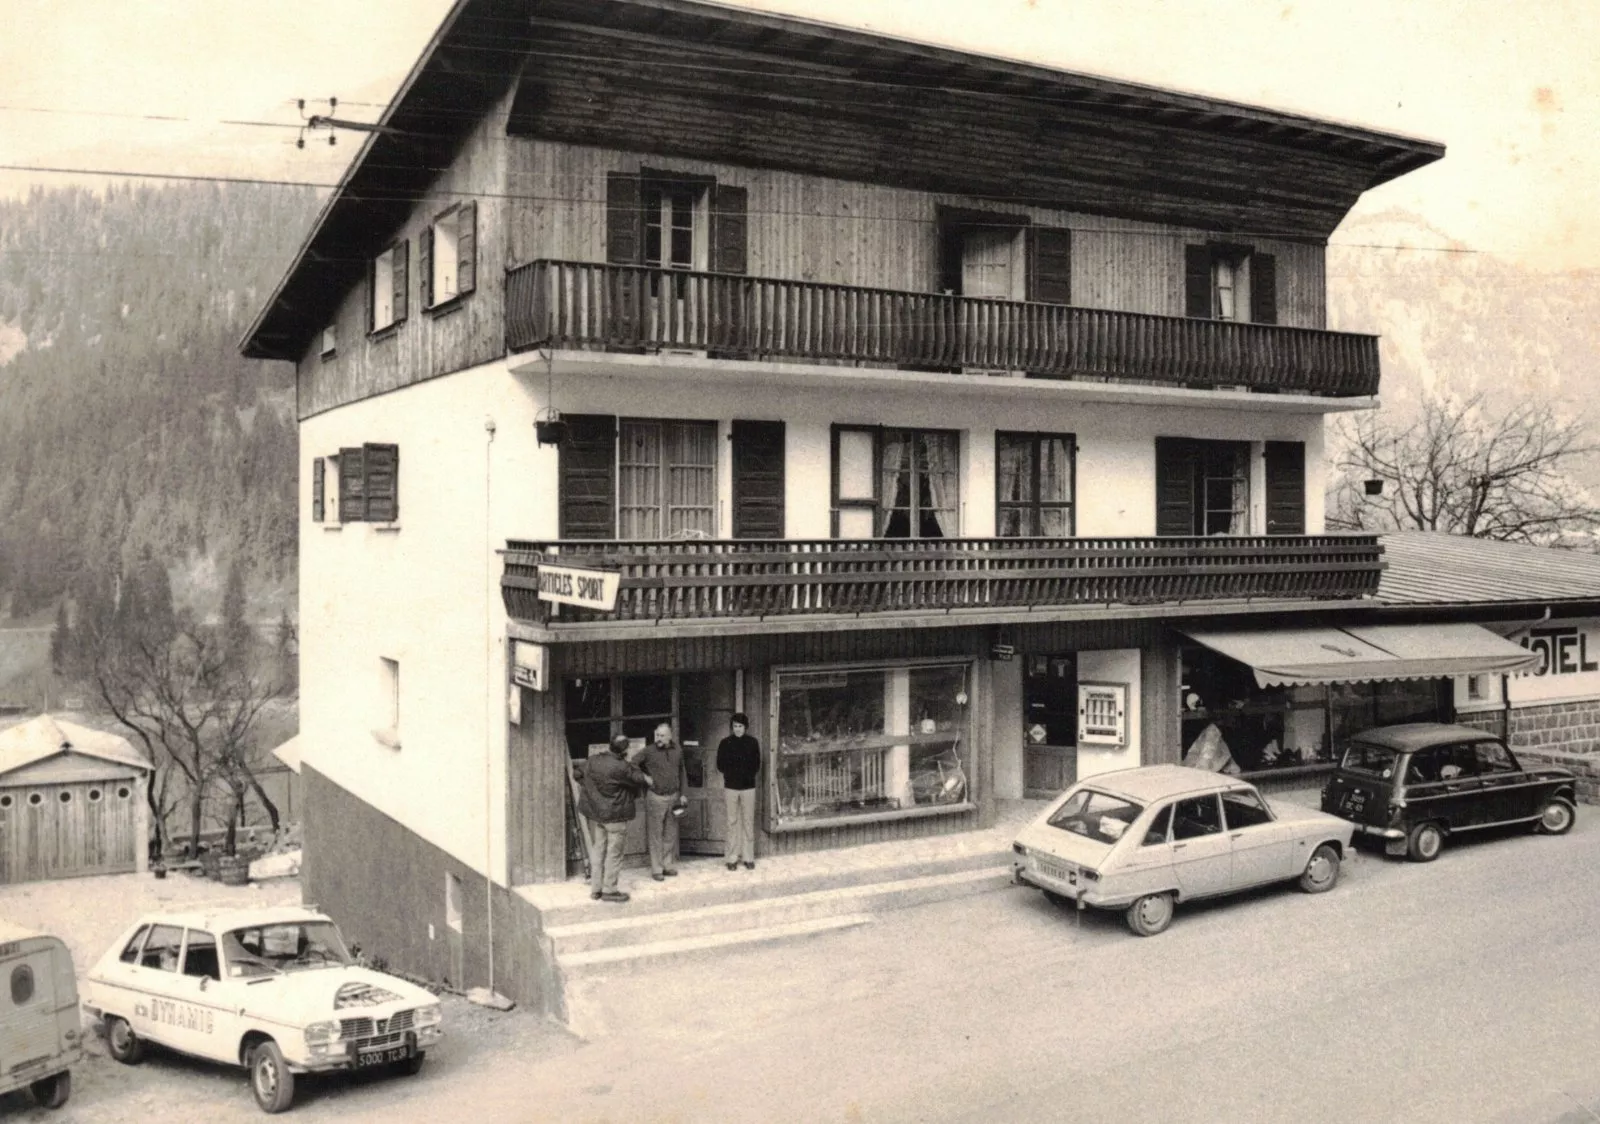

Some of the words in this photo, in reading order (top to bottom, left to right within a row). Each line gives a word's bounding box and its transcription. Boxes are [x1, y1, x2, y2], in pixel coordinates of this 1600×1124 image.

[577, 575, 604, 602] SPORT
[1514, 627, 1599, 680] OTEL
[151, 998, 214, 1034] DYNAMIC
